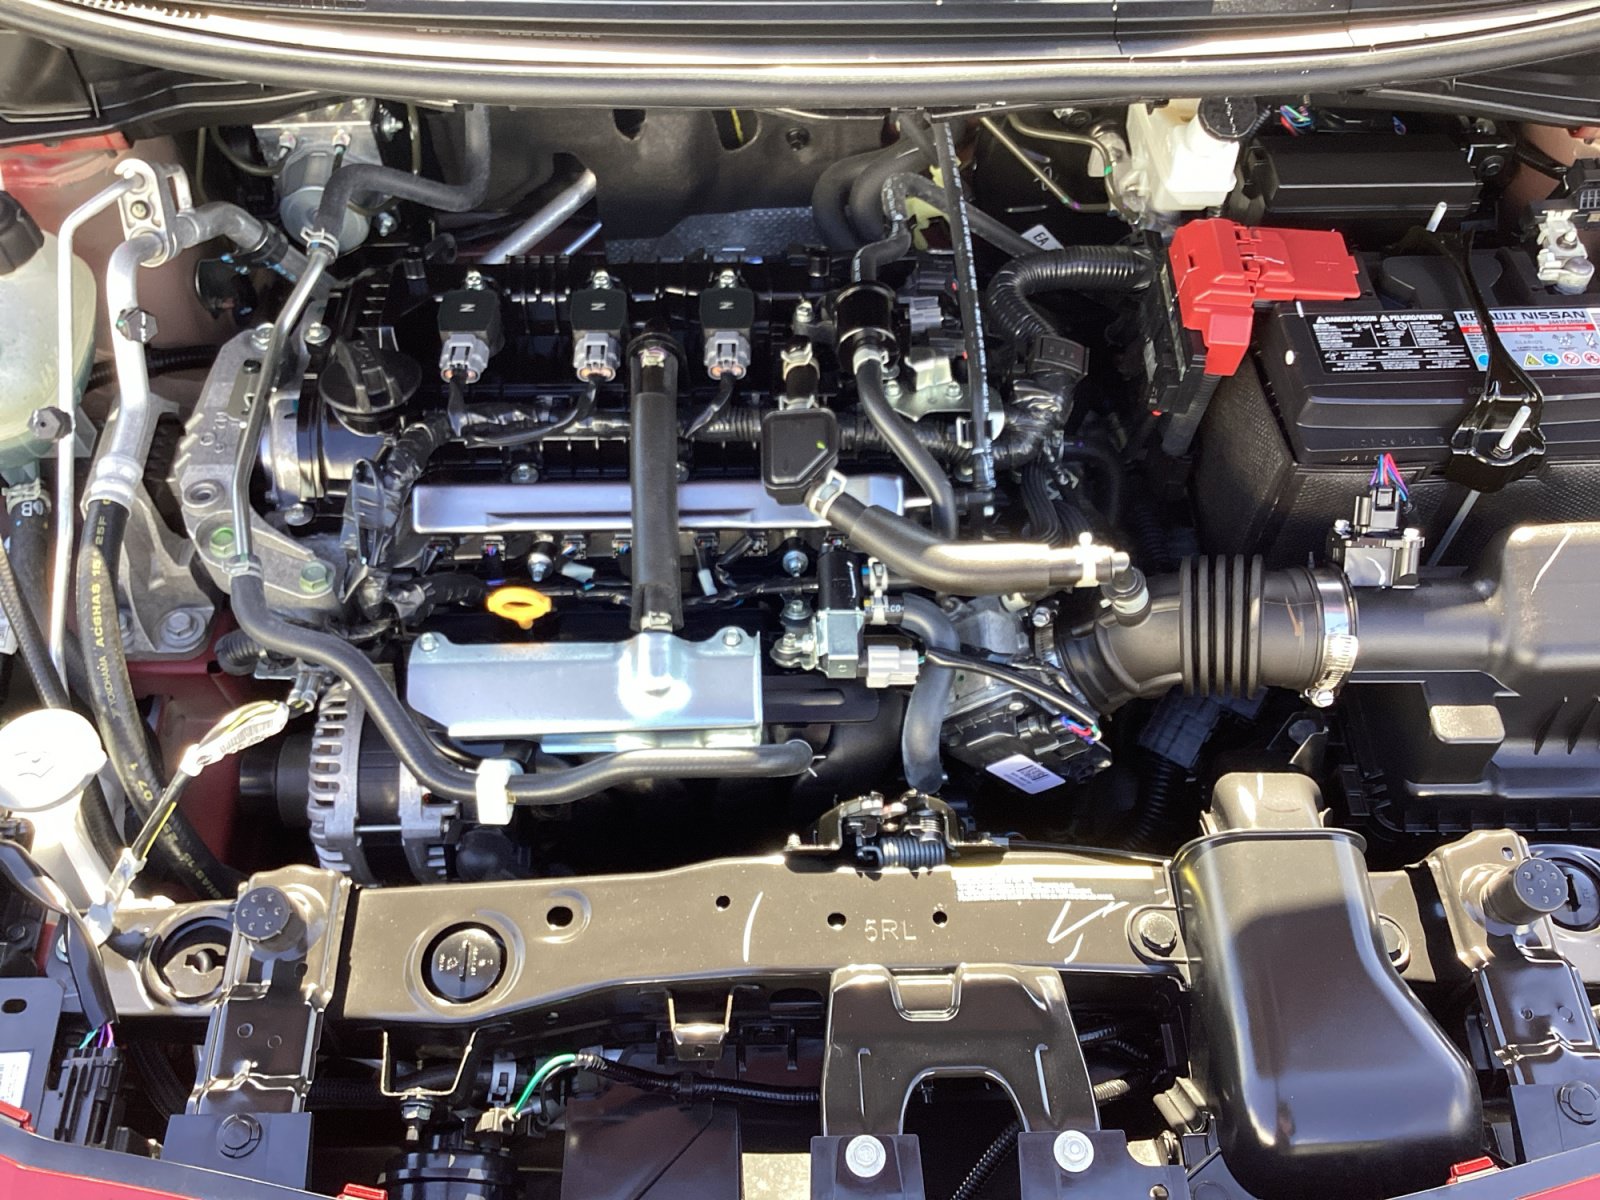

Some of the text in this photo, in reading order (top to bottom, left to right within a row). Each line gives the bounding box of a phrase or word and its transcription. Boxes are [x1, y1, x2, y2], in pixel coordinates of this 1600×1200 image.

[1033, 231, 1049, 247] EA
[1325, 315, 1378, 323] DANGER/POISON
[1459, 310, 1587, 321] REULT NISSAN
[98, 655, 117, 706] YOKOHAMA
[864, 918, 917, 942] 5RL
